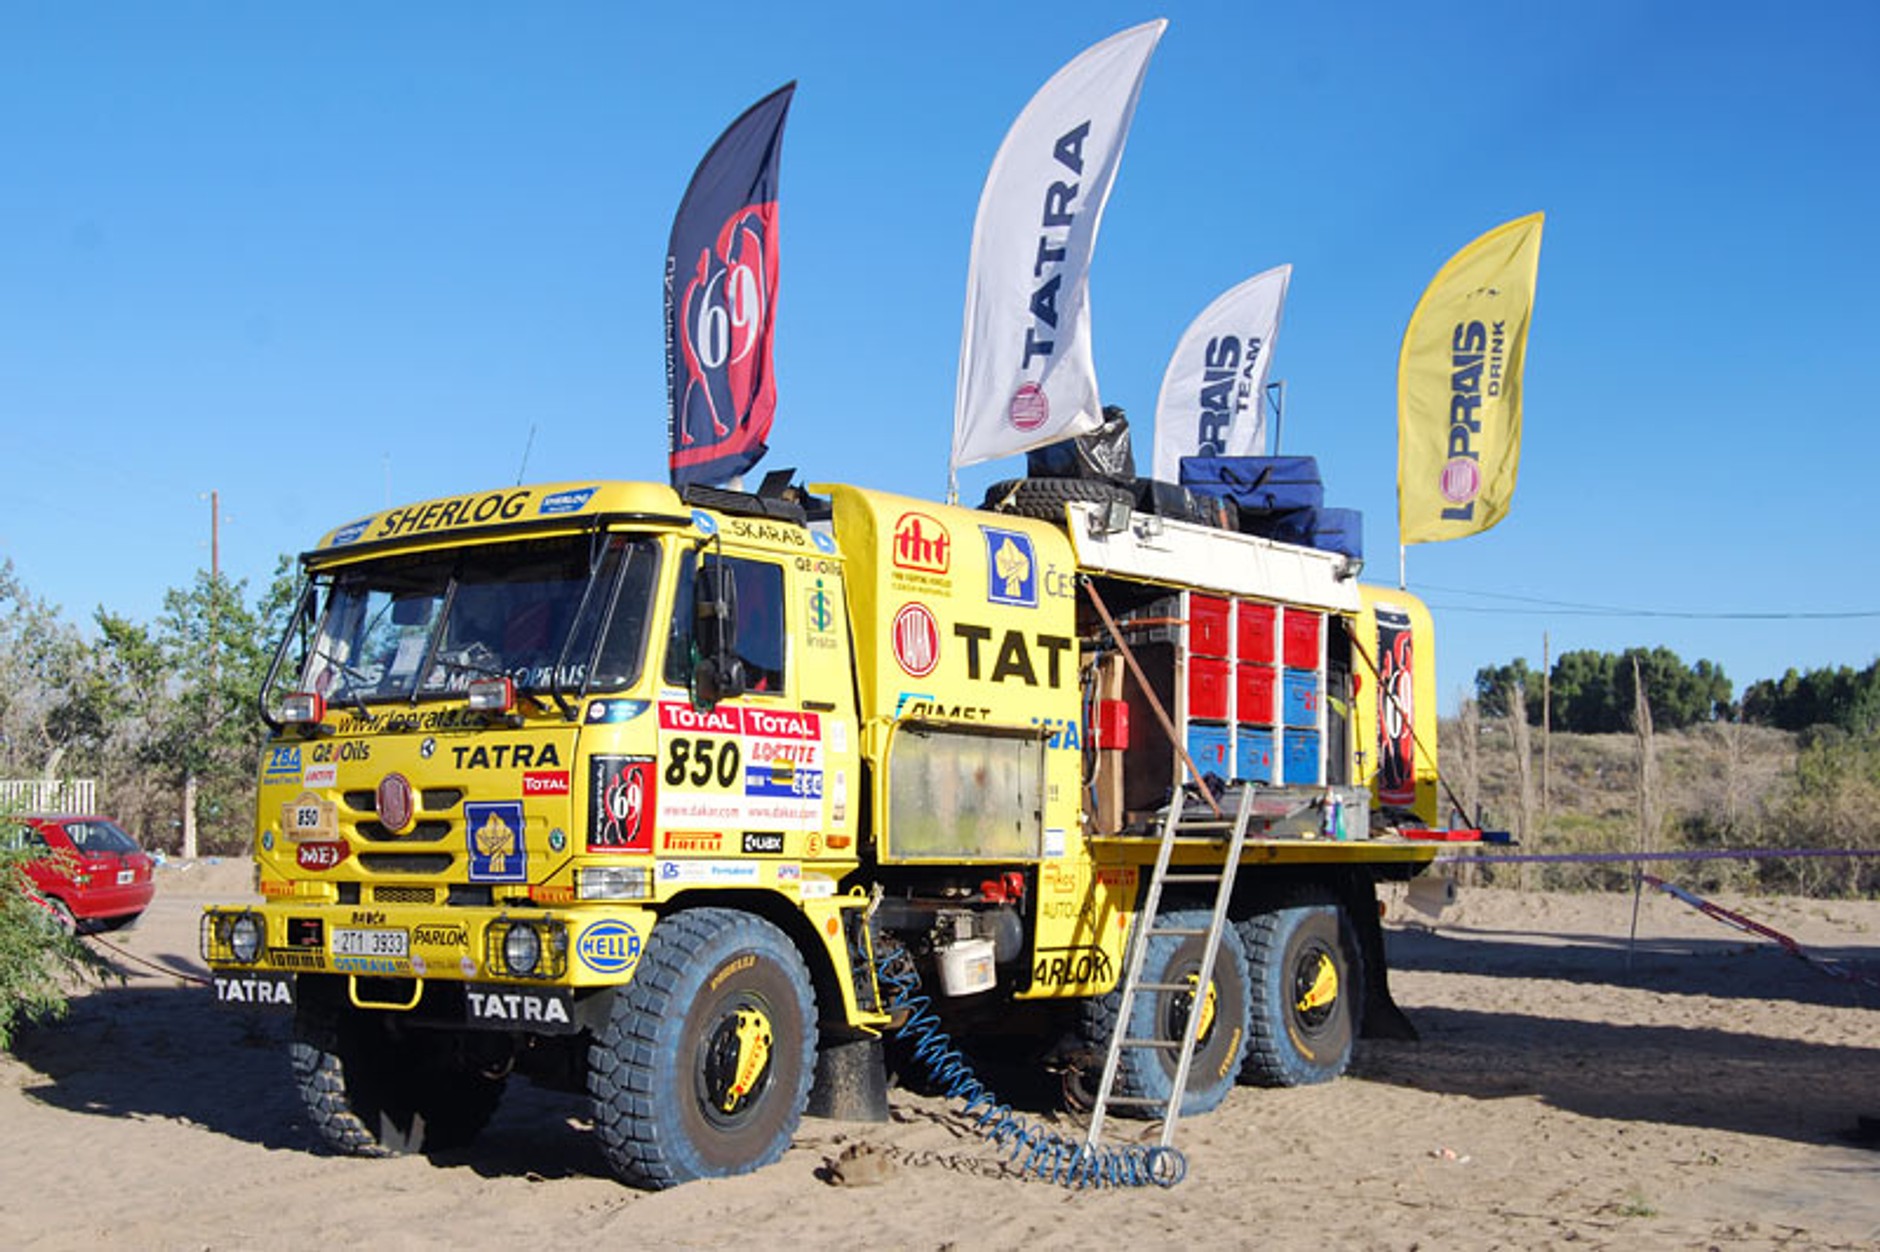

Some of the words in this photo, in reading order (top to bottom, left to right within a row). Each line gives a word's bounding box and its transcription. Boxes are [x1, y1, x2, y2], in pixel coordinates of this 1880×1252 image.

[1022, 120, 1091, 370] TATRA
[698, 264, 758, 369] 69
[1487, 319, 1505, 397] DRINK
[1236, 336, 1262, 415] TEAM
[1440, 319, 1488, 522] LPRAIS
[377, 490, 531, 538] SHERLOG
[953, 622, 1072, 690] TAT
[665, 705, 735, 730] TOTAL
[750, 712, 815, 736] TOTAL
[452, 743, 561, 770] TATRA
[664, 737, 740, 788] 850
[751, 742, 816, 763] LOCTITE
[524, 776, 568, 791] TOTAL
[298, 807, 317, 826] 850
[663, 804, 740, 819] www.dakar.com
[664, 831, 722, 851] PIRELLI
[341, 931, 364, 953] 2T1
[413, 929, 469, 947] PARLOK
[583, 936, 641, 959] HELLA
[1034, 955, 1108, 987] ARLOK
[213, 978, 293, 1005] TATRA
[467, 992, 571, 1024] TATRA
